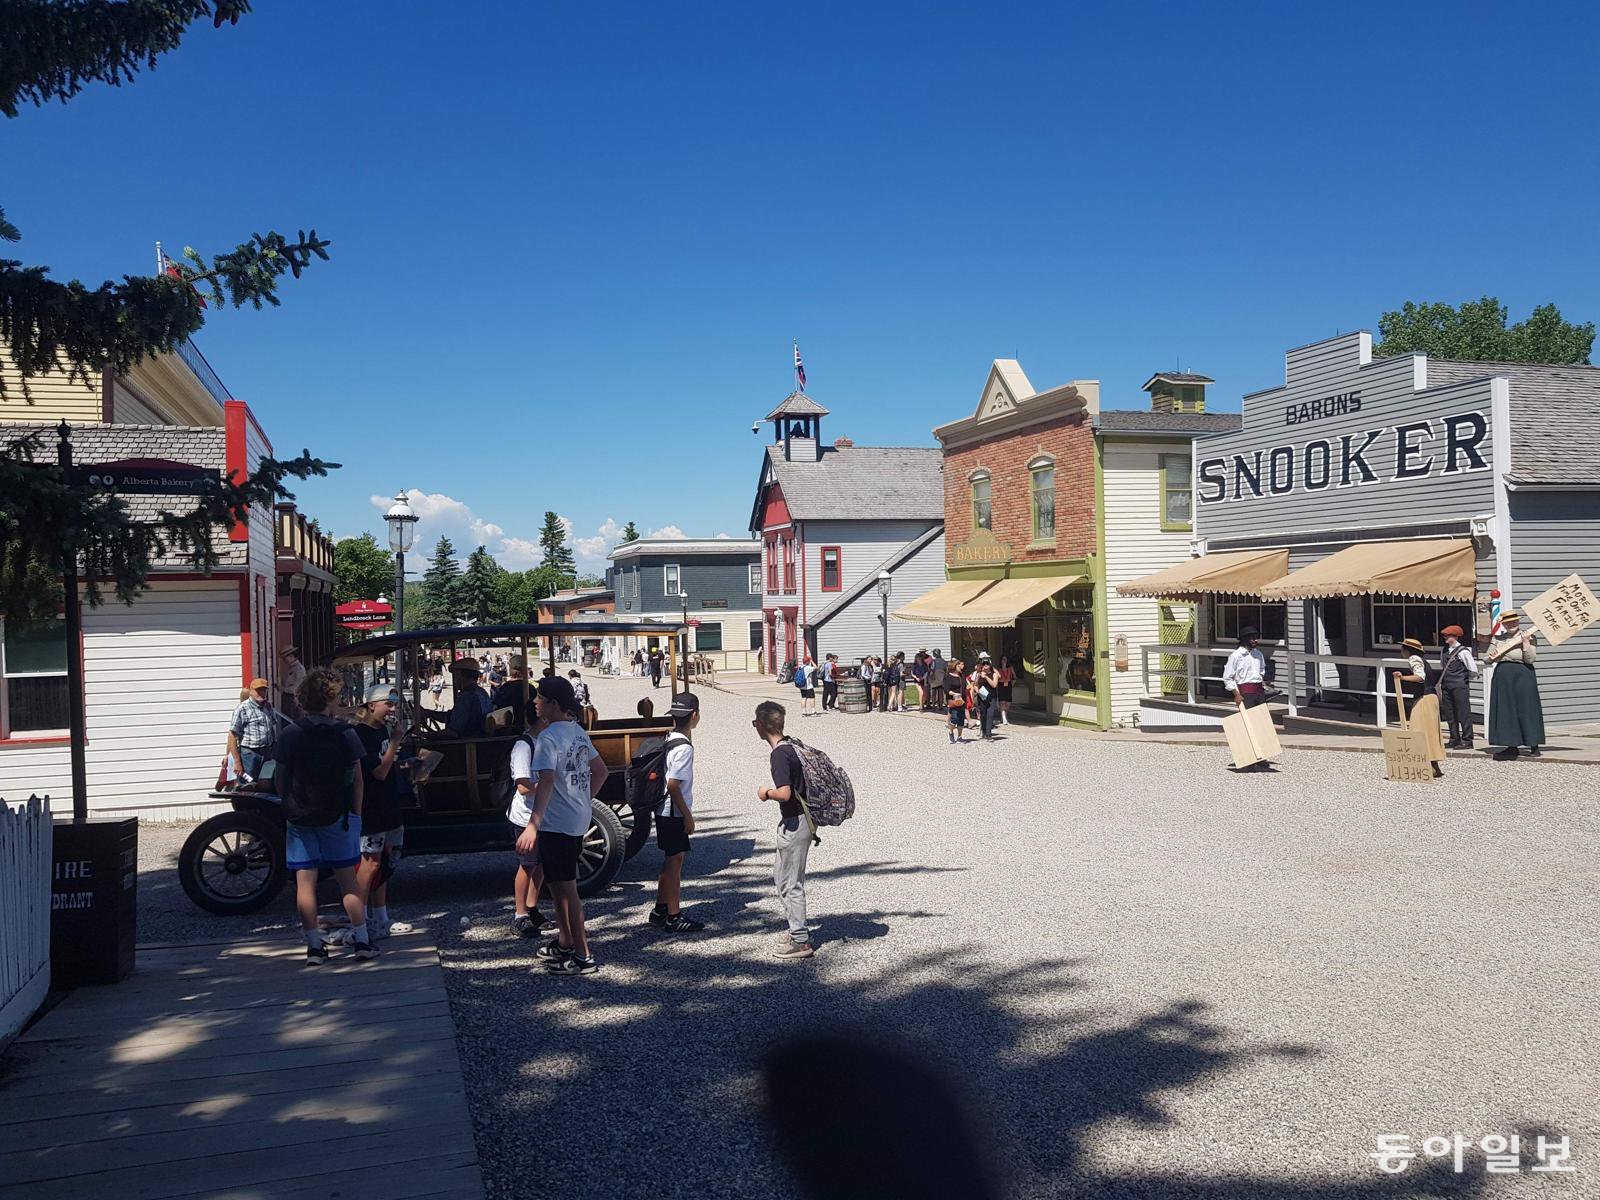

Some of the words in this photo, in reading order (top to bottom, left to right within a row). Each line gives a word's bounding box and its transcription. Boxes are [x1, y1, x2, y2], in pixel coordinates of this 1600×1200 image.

[1285, 391, 1363, 425] BARONS
[1198, 410, 1491, 504] SNOOKER
[122, 476, 160, 485] Alberta
[161, 478, 194, 488] Bakery
[957, 546, 1008, 560] BAKERY
[1569, 583, 1590, 608] MORE
[1542, 608, 1561, 631] TIME
[1551, 596, 1579, 628] FAMILY
[1390, 765, 1430, 781] SAFETY
[55, 860, 93, 879] IRE
[52, 892, 93, 909] DRANT
